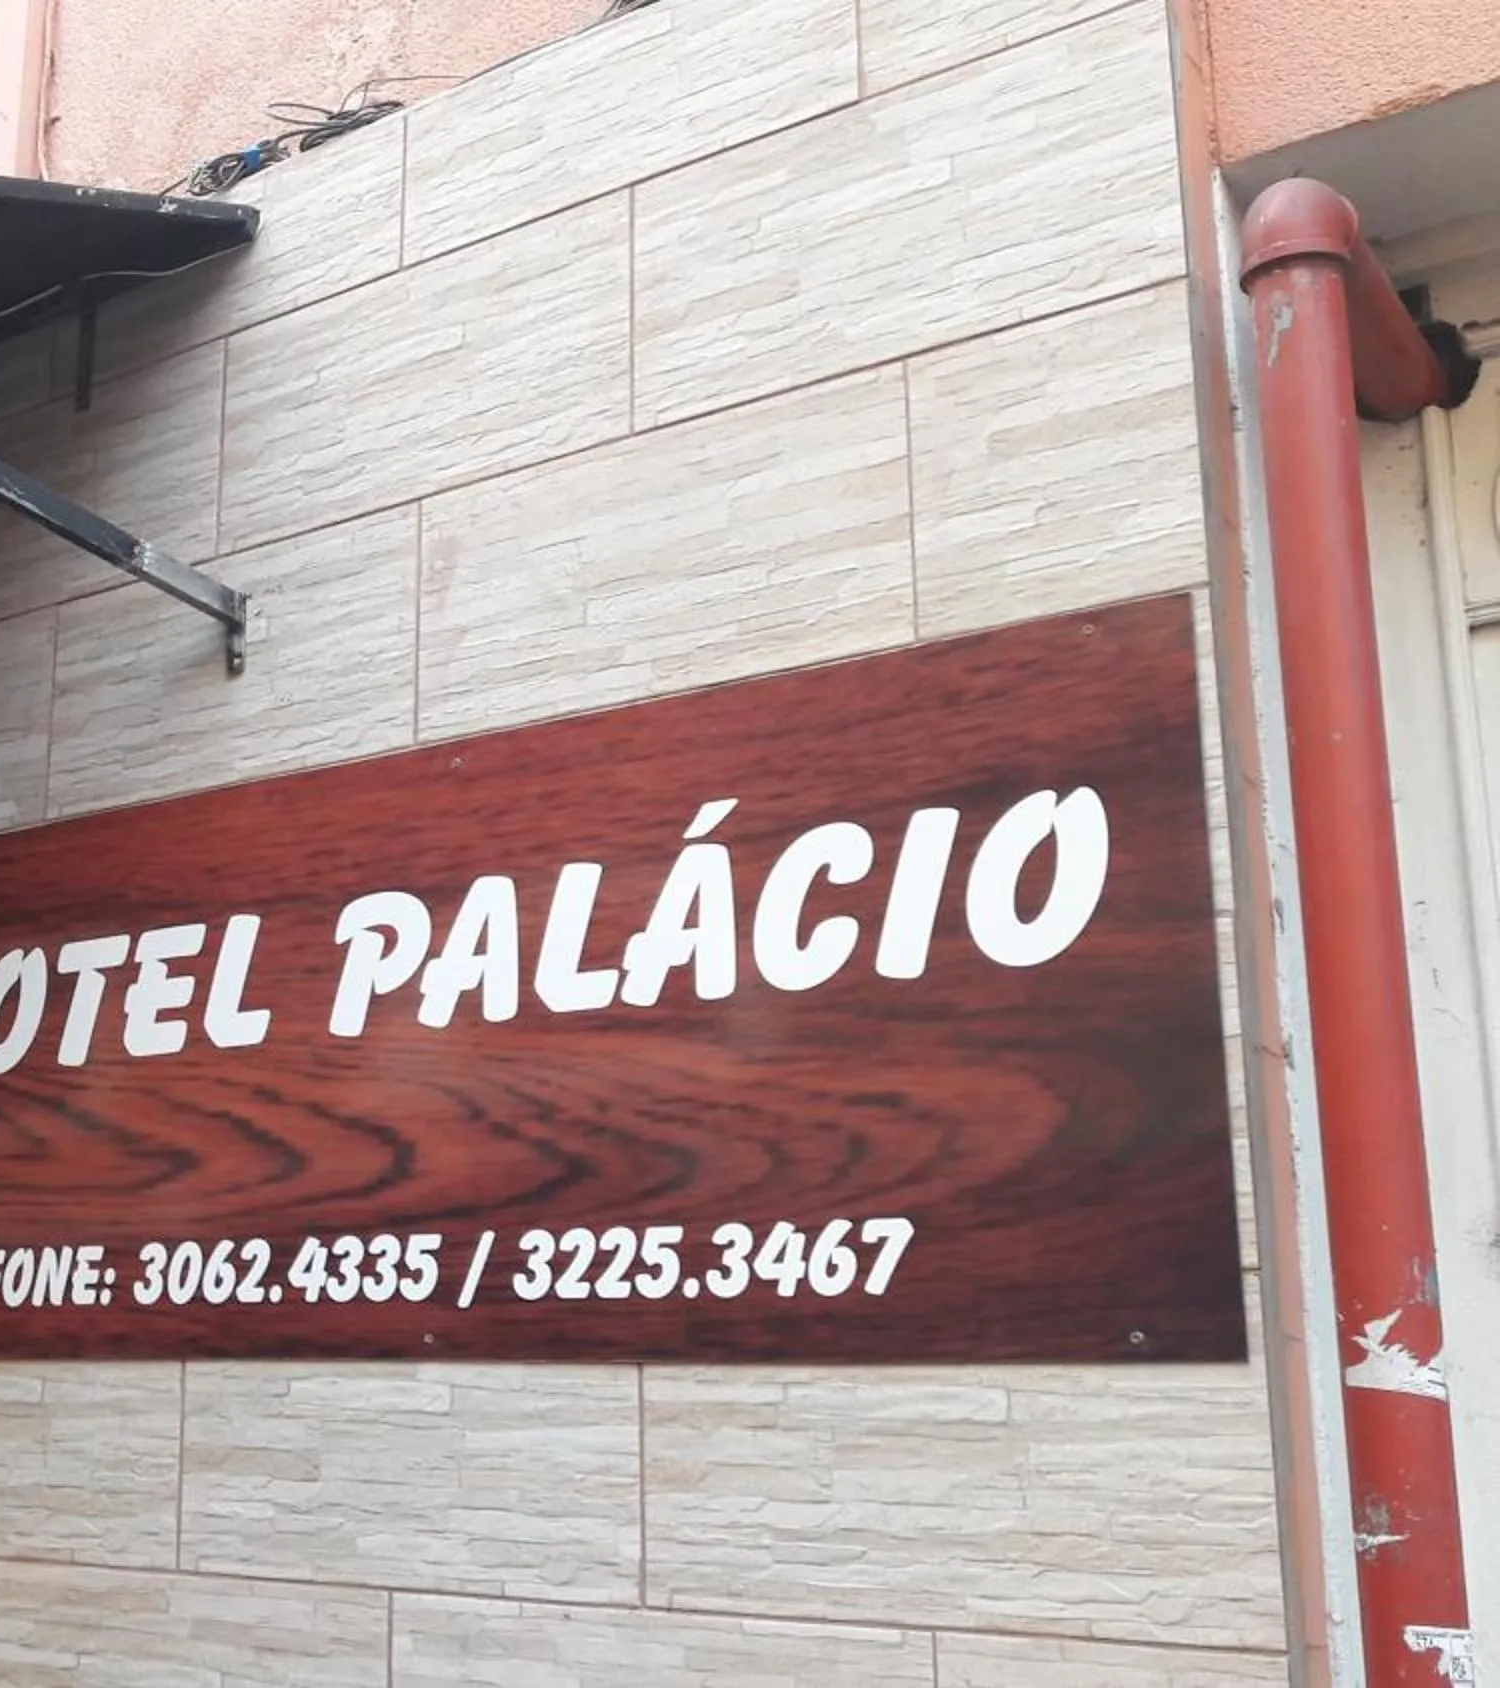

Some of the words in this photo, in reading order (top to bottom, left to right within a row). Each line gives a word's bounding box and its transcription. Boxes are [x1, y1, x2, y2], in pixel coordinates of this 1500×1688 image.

[329, 786, 1109, 1037] PALÁCIO
[133, 1233, 442, 1305] 3062.4335
[512, 1217, 915, 1301] 3225.3467
